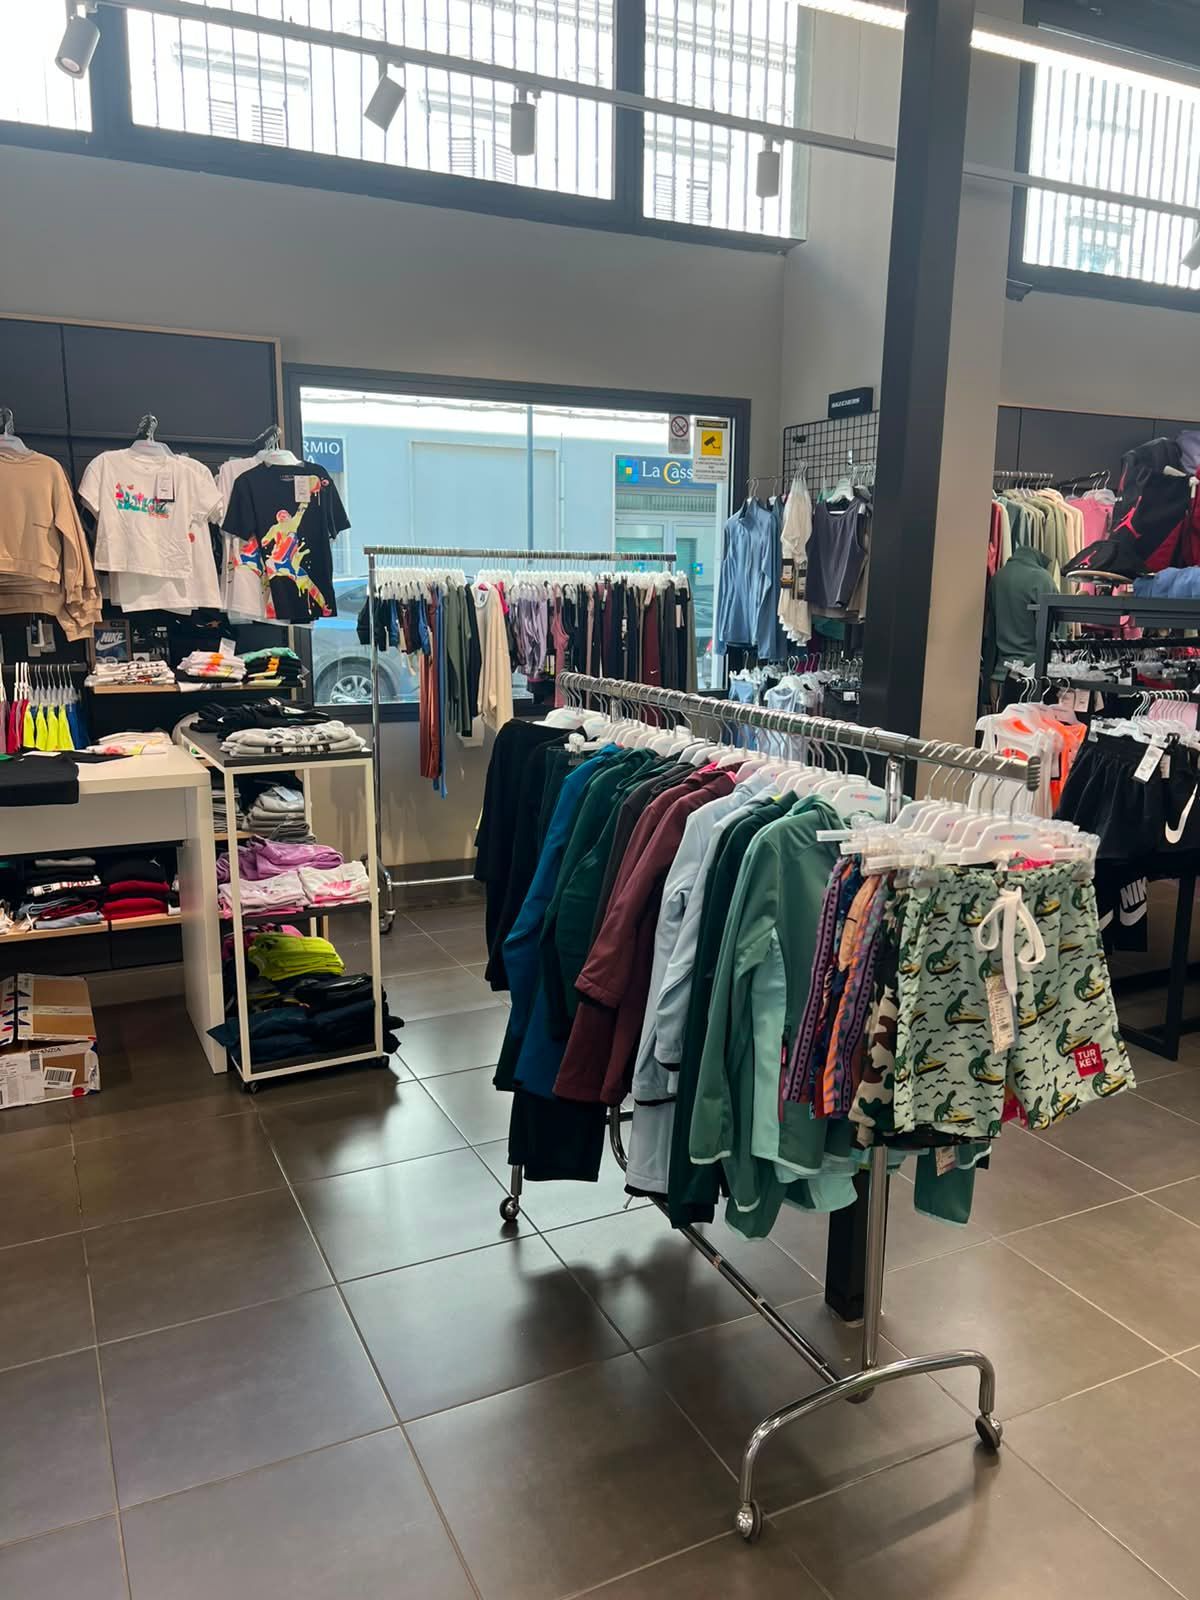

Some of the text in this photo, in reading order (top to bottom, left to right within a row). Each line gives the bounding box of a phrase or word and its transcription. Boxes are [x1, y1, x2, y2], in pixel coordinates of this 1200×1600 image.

[303, 440, 341, 455] RMIO
[641, 460, 661, 478] La
[663, 461, 694, 485] Cass
[100, 631, 124, 643] NIKE
[1120, 876, 1147, 909] NIK
[1077, 1049, 1096, 1059] TUR
[1079, 1056, 1097, 1068] KEY
